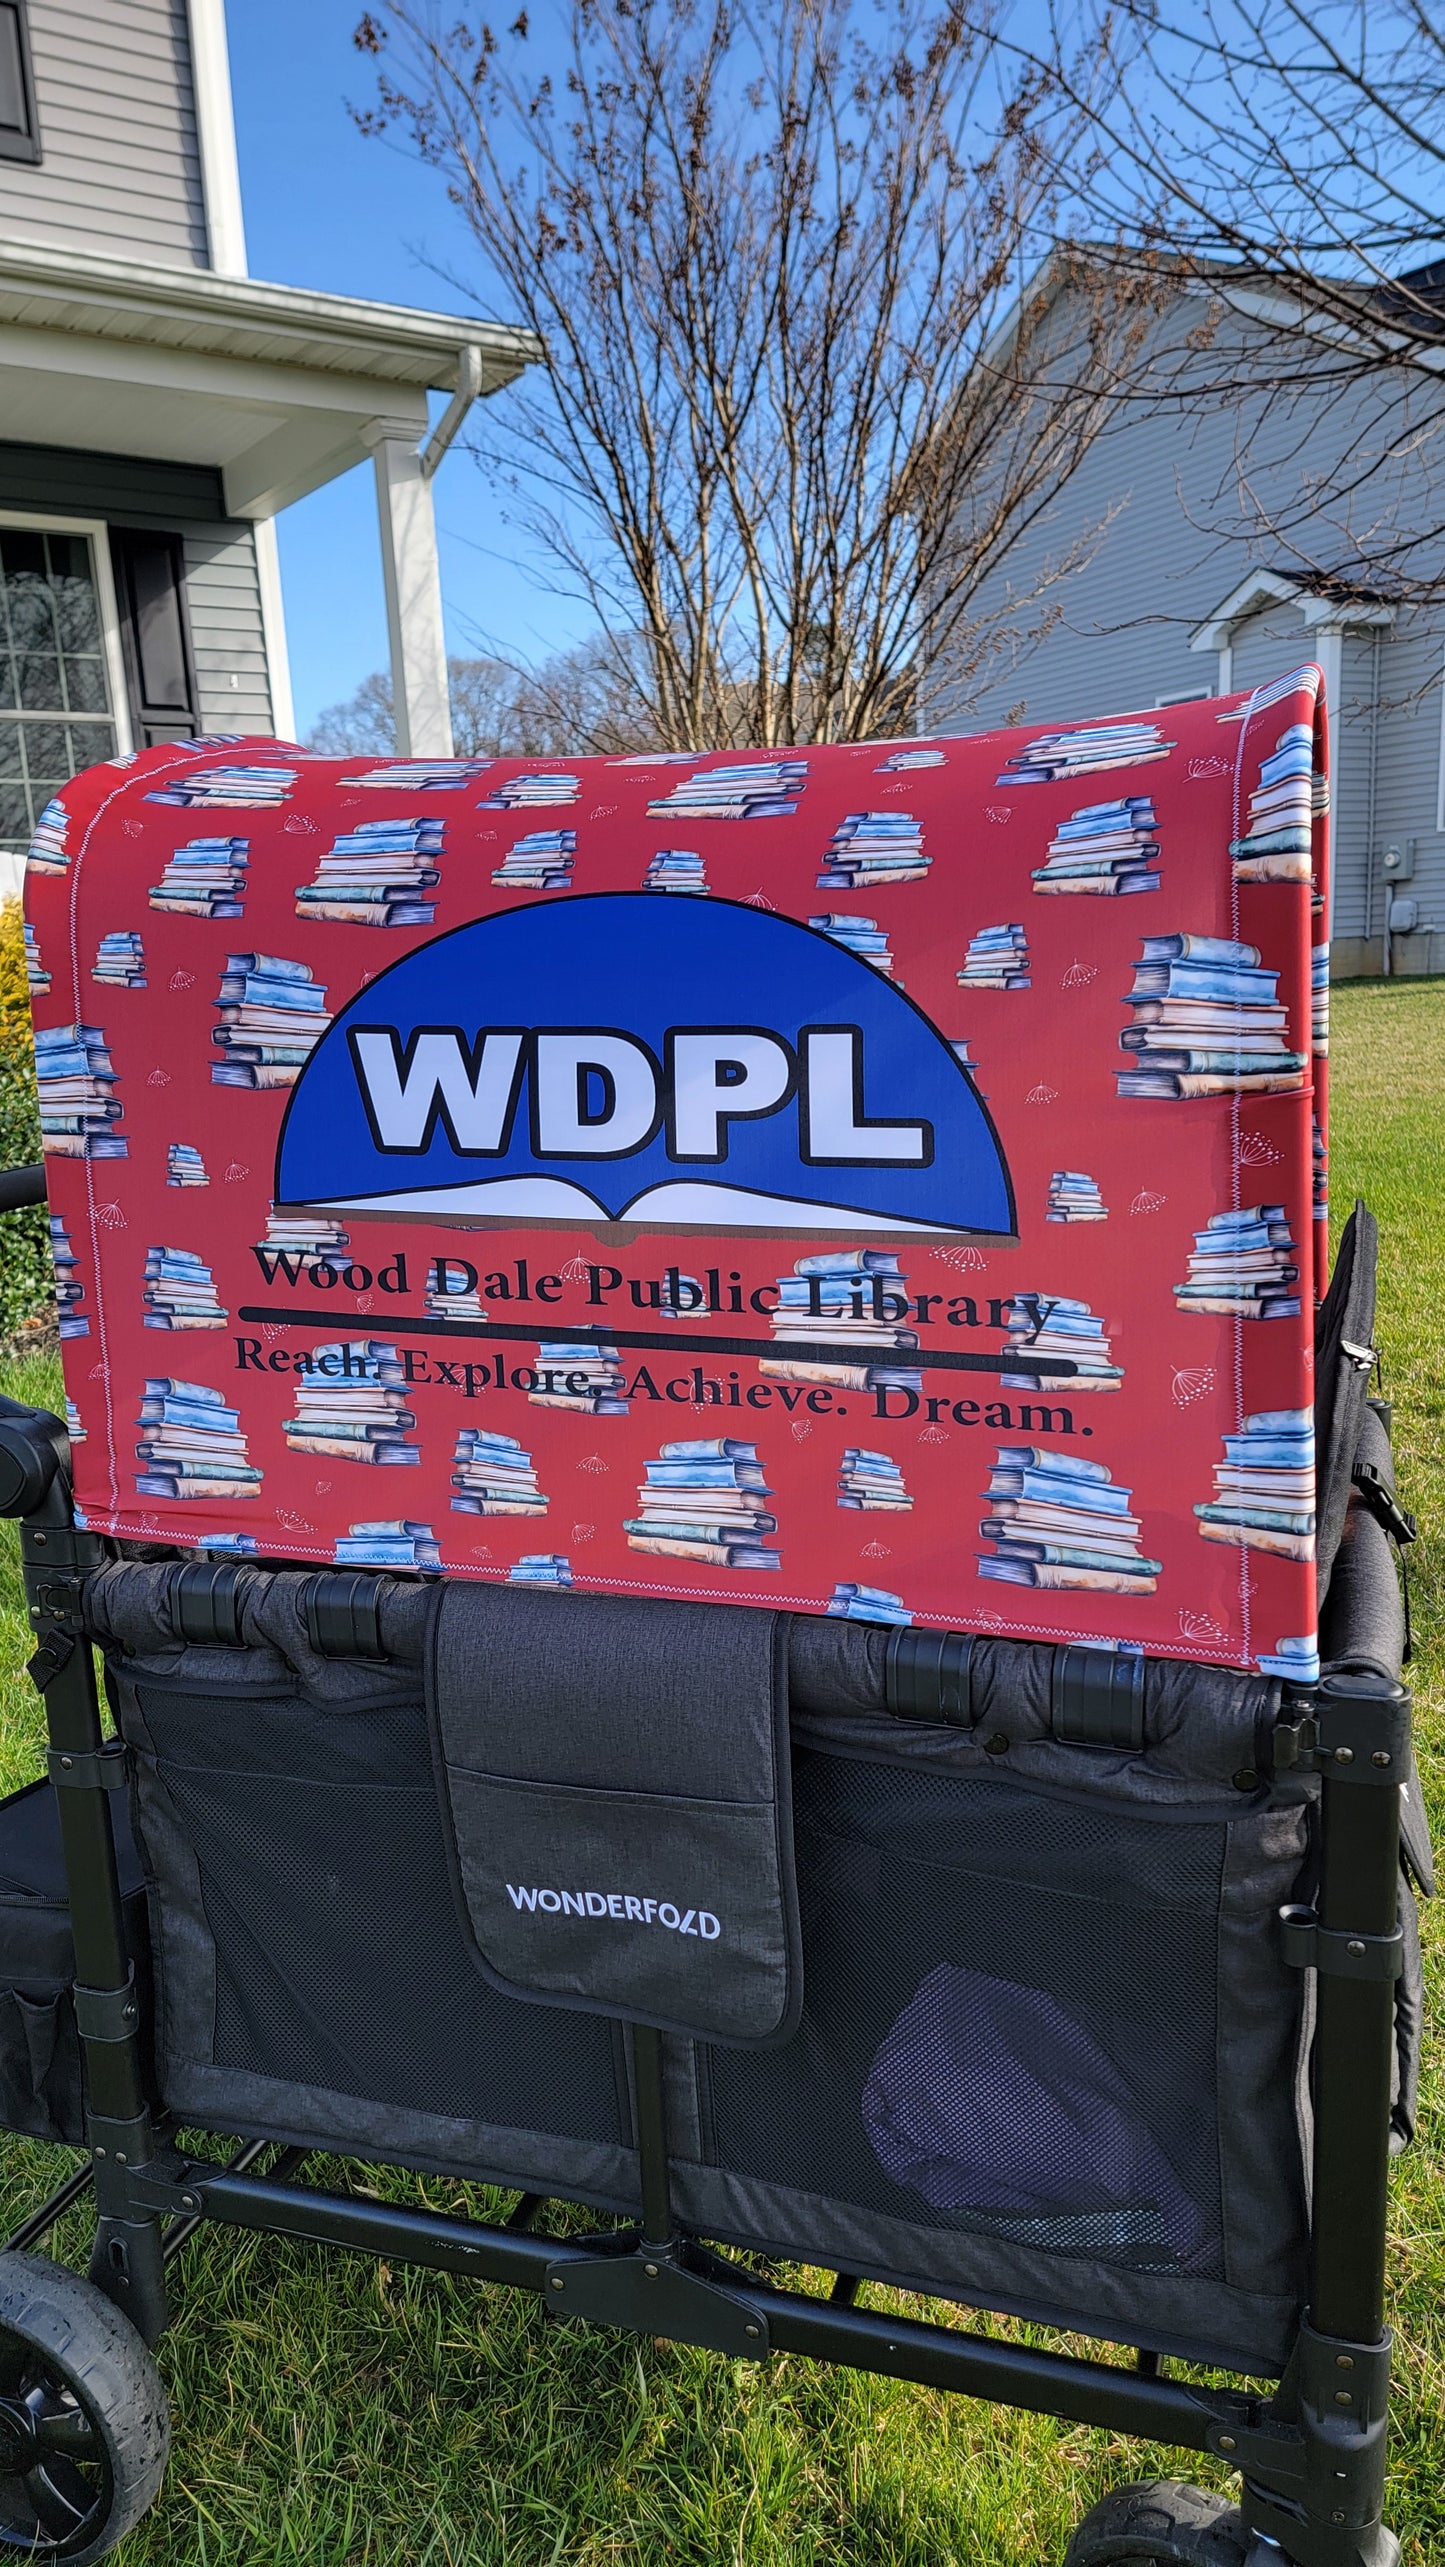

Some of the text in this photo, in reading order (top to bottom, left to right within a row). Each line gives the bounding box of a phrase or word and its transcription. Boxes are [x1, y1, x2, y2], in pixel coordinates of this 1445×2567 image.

[348, 1026, 934, 1166] WDPL
[249, 1246, 1060, 1345] Wood Dale Public Library
[232, 1336, 1093, 1436] Reach. Explore. Achieve. Dream.
[505, 1883, 721, 1940] WONDERFOLD
